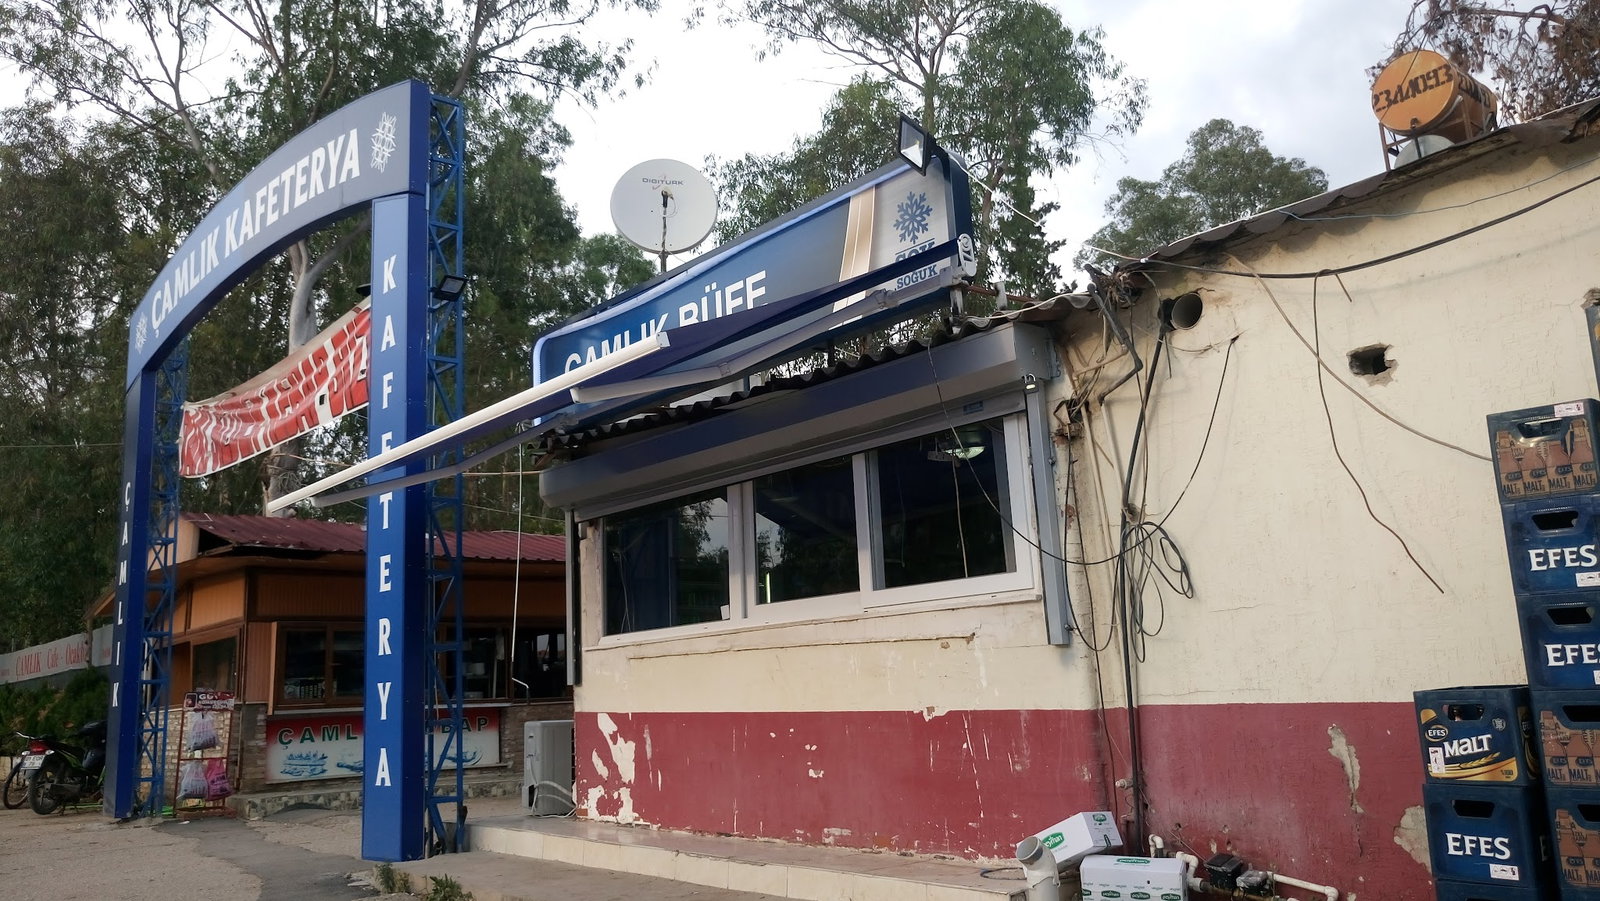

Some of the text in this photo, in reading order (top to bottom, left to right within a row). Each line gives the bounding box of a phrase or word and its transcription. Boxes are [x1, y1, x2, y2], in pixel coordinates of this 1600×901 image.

[151, 128, 361, 338] ÇAMLIK KAFETERYA
[1528, 544, 1598, 571] EFES
[112, 481, 131, 707] ÇAMLIK
[1544, 643, 1600, 667] EFE
[1428, 729, 1446, 737] EFES
[1445, 832, 1511, 860] EFES
